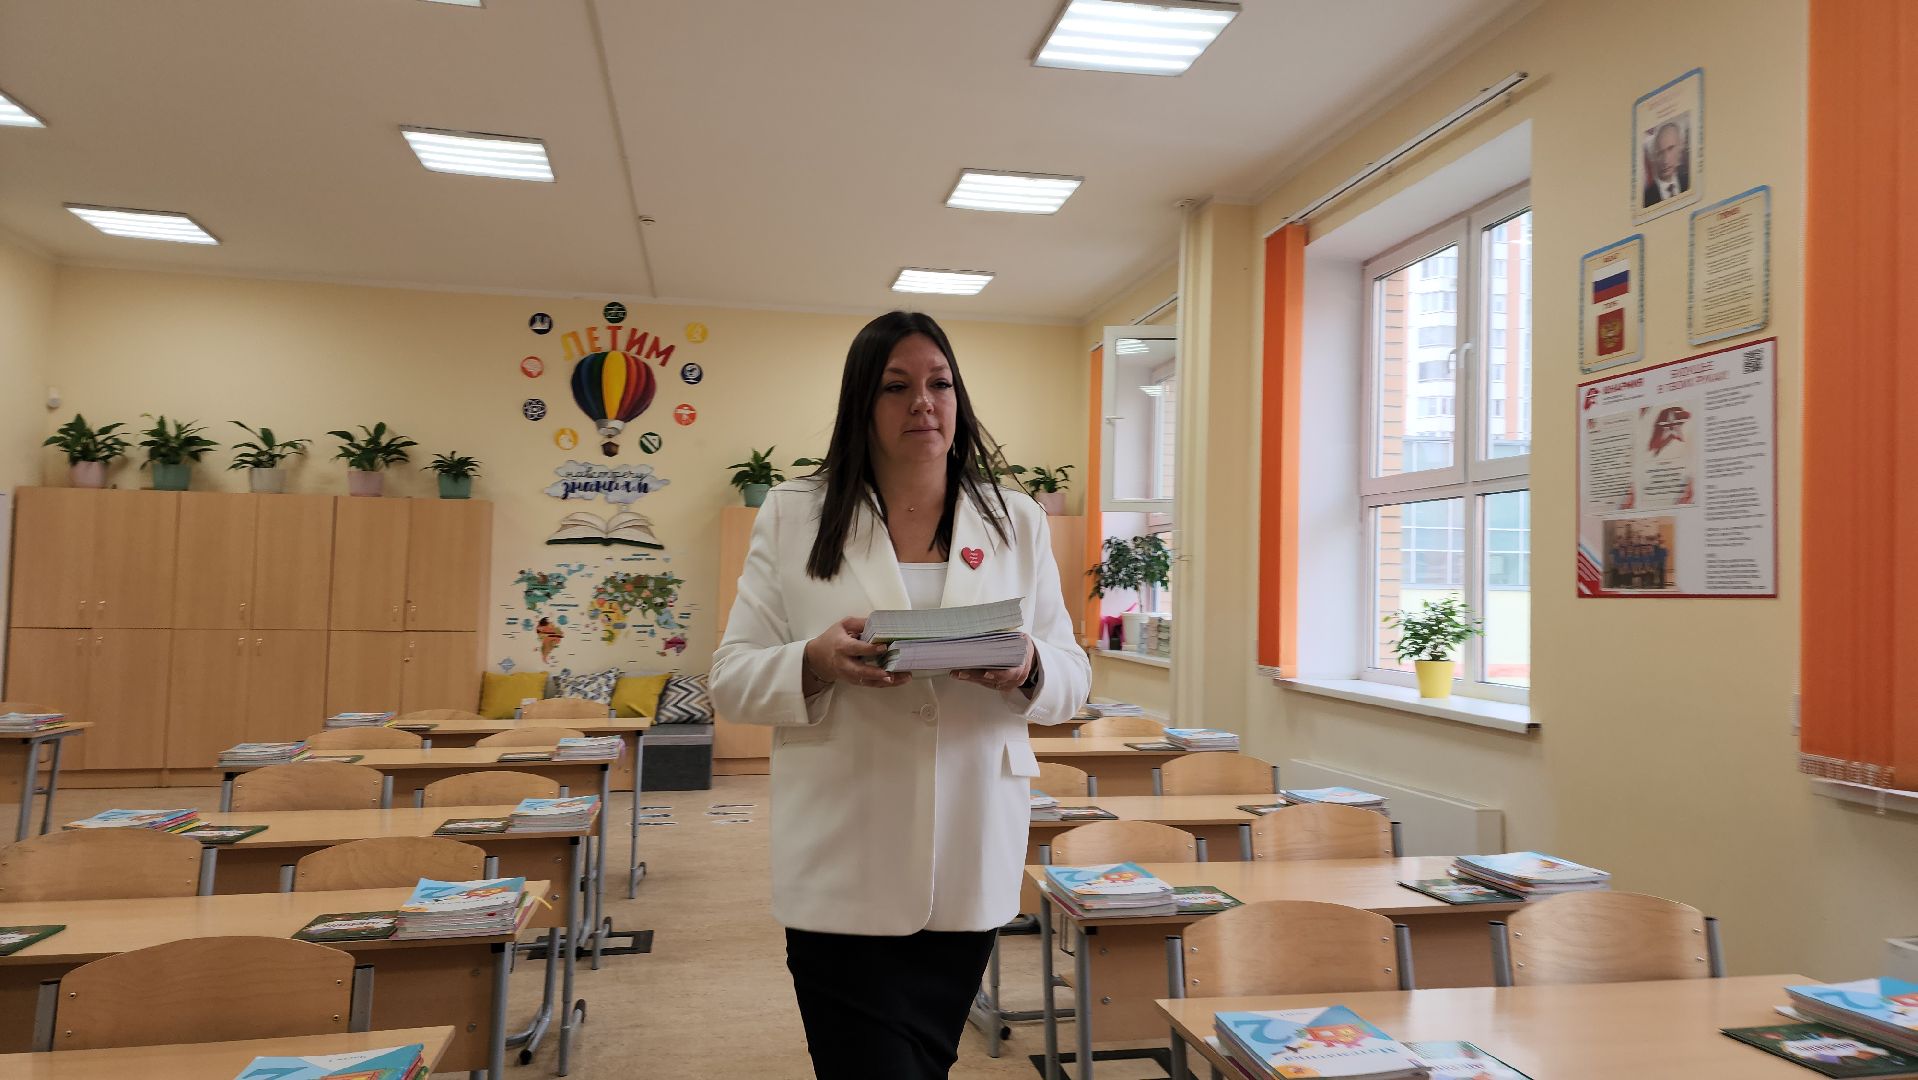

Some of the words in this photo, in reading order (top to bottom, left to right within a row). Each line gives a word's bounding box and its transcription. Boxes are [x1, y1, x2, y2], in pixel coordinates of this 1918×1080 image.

[561, 325, 676, 367] ЛЕТИМ
[561, 480, 649, 499] знаниям
[1233, 1019, 1292, 1044] 2
